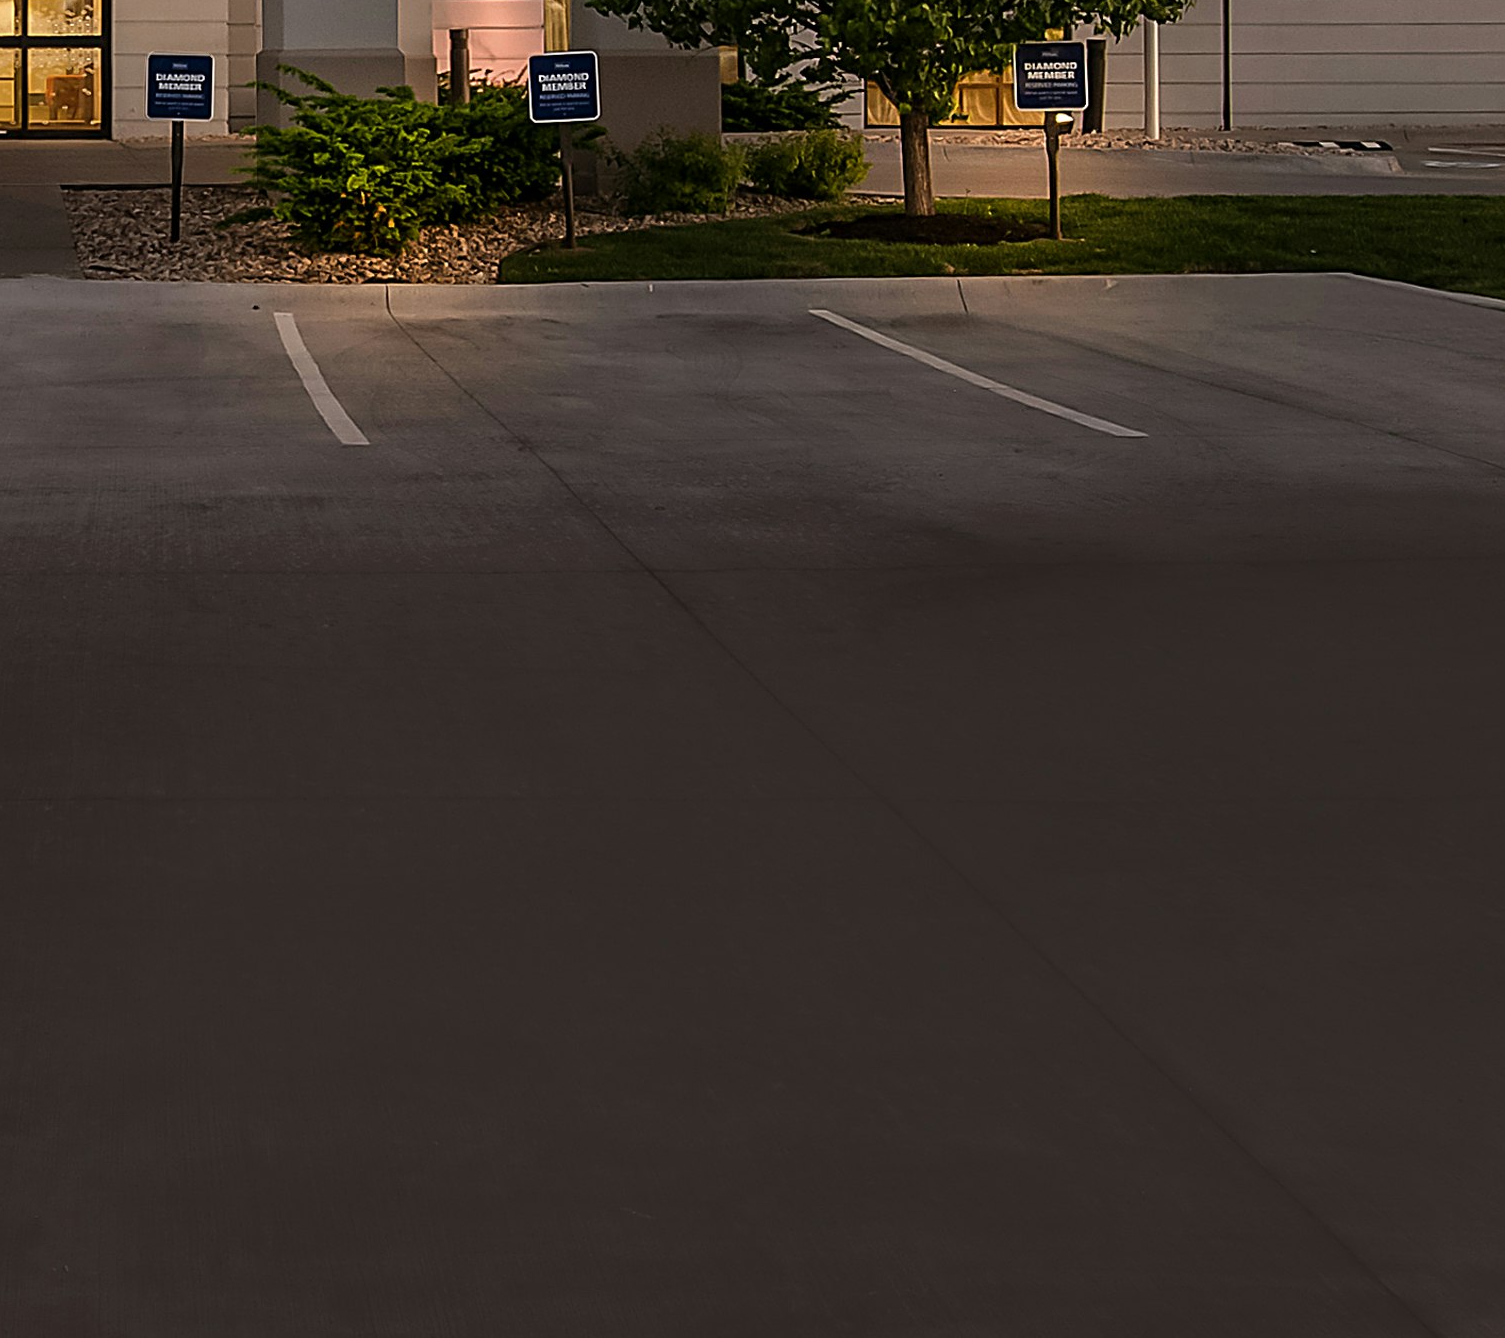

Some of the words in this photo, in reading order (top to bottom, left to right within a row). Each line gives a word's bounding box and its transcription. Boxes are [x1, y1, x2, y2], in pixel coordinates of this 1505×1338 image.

[1024, 61, 1078, 71] DIAMOND
[155, 73, 206, 82] DIAMOND
[538, 72, 590, 83] DIAMOND
[1027, 71, 1075, 80] MEMBER
[158, 82, 202, 91] MEMBER
[541, 82, 587, 92] MEMBER
